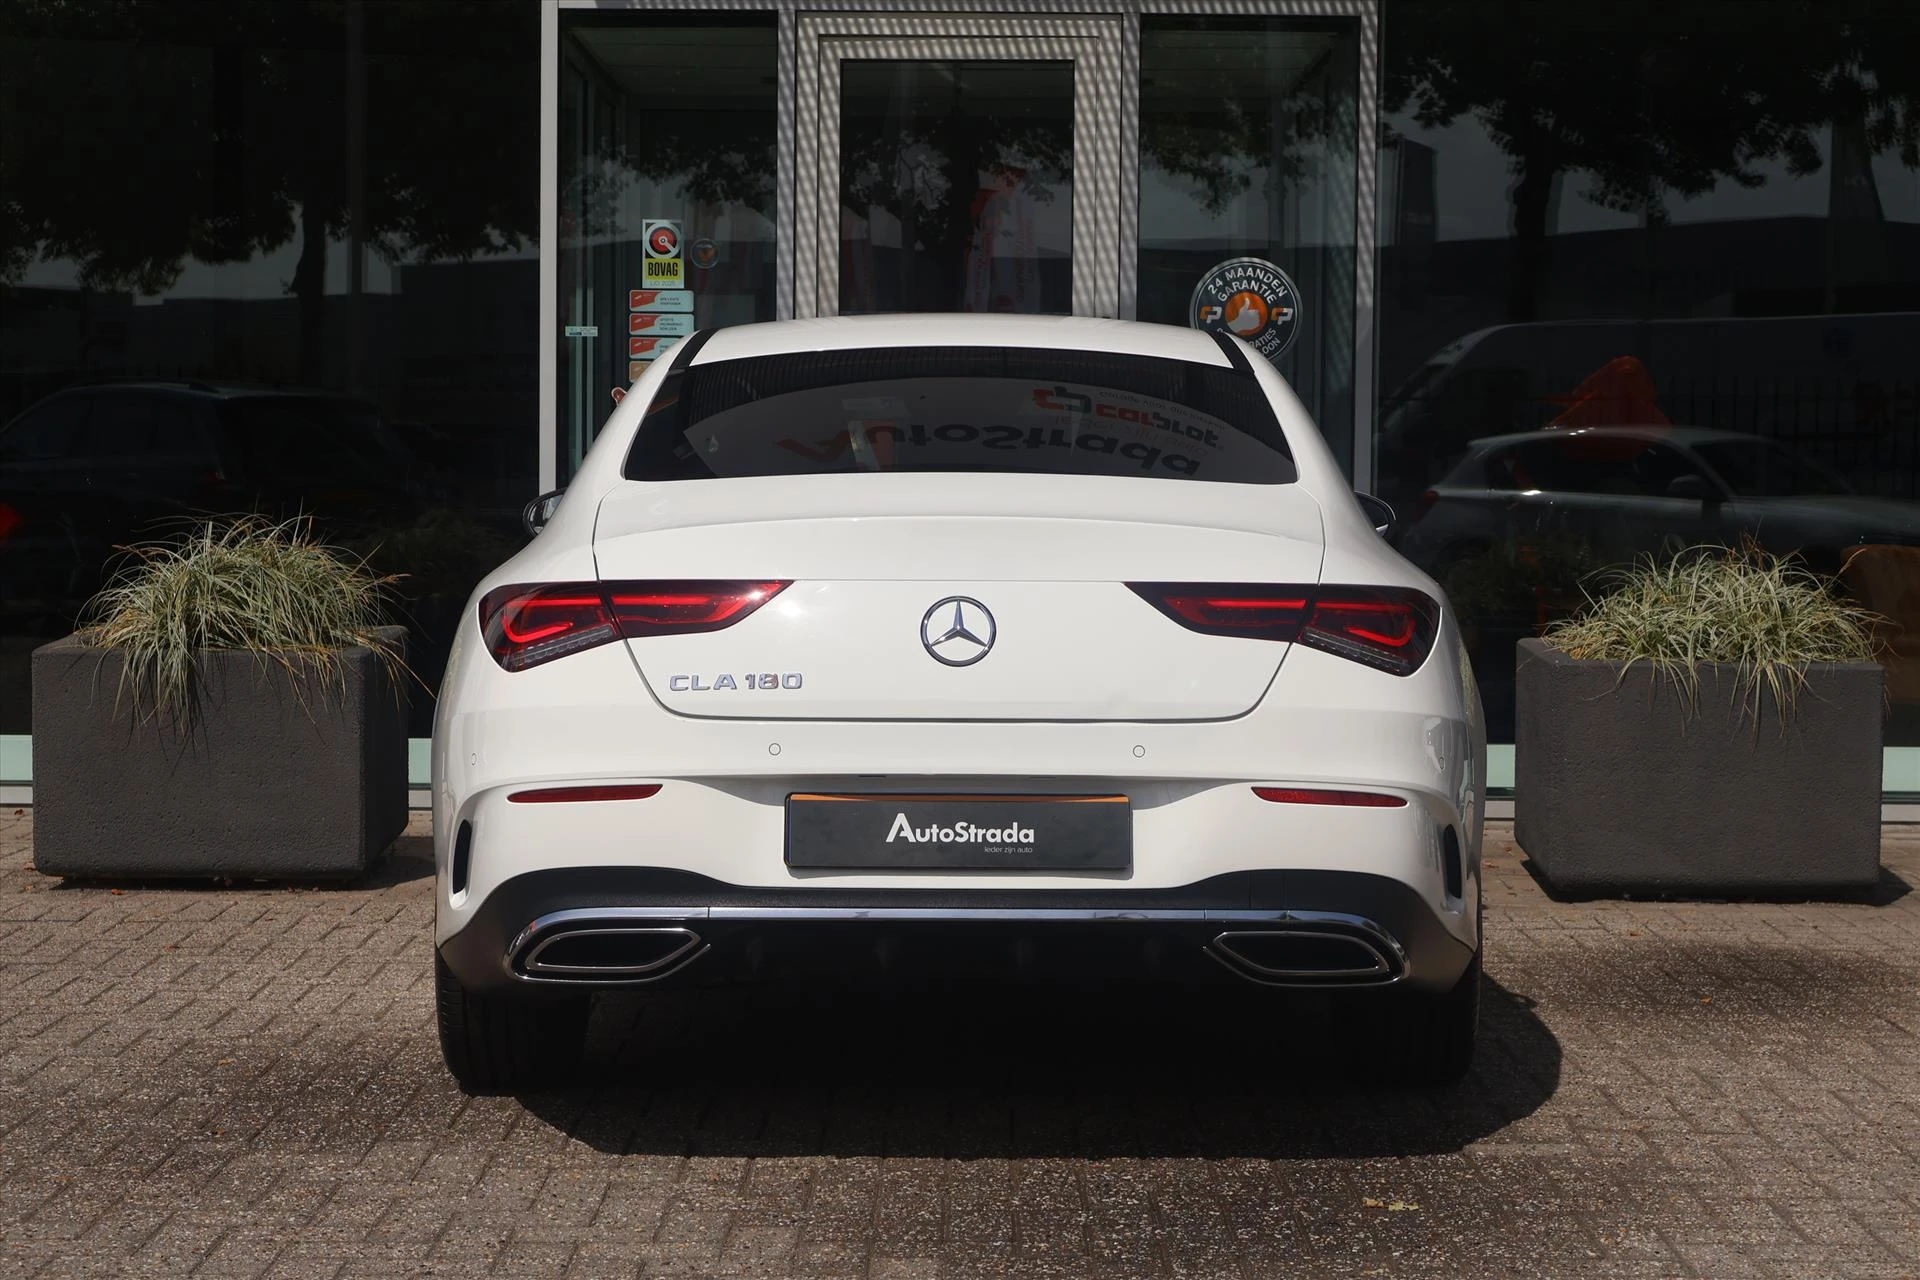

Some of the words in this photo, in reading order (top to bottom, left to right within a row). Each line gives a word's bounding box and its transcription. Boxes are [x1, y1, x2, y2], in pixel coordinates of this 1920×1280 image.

[648, 262, 678, 277] BOVAG
[1207, 278, 1223, 295] 24
[1225, 267, 1288, 297] MAANDEN
[1217, 280, 1277, 304] GARANTIE
[669, 673, 738, 692] CLA
[744, 672, 803, 691] 180
[885, 812, 1035, 844] AutoStrada
